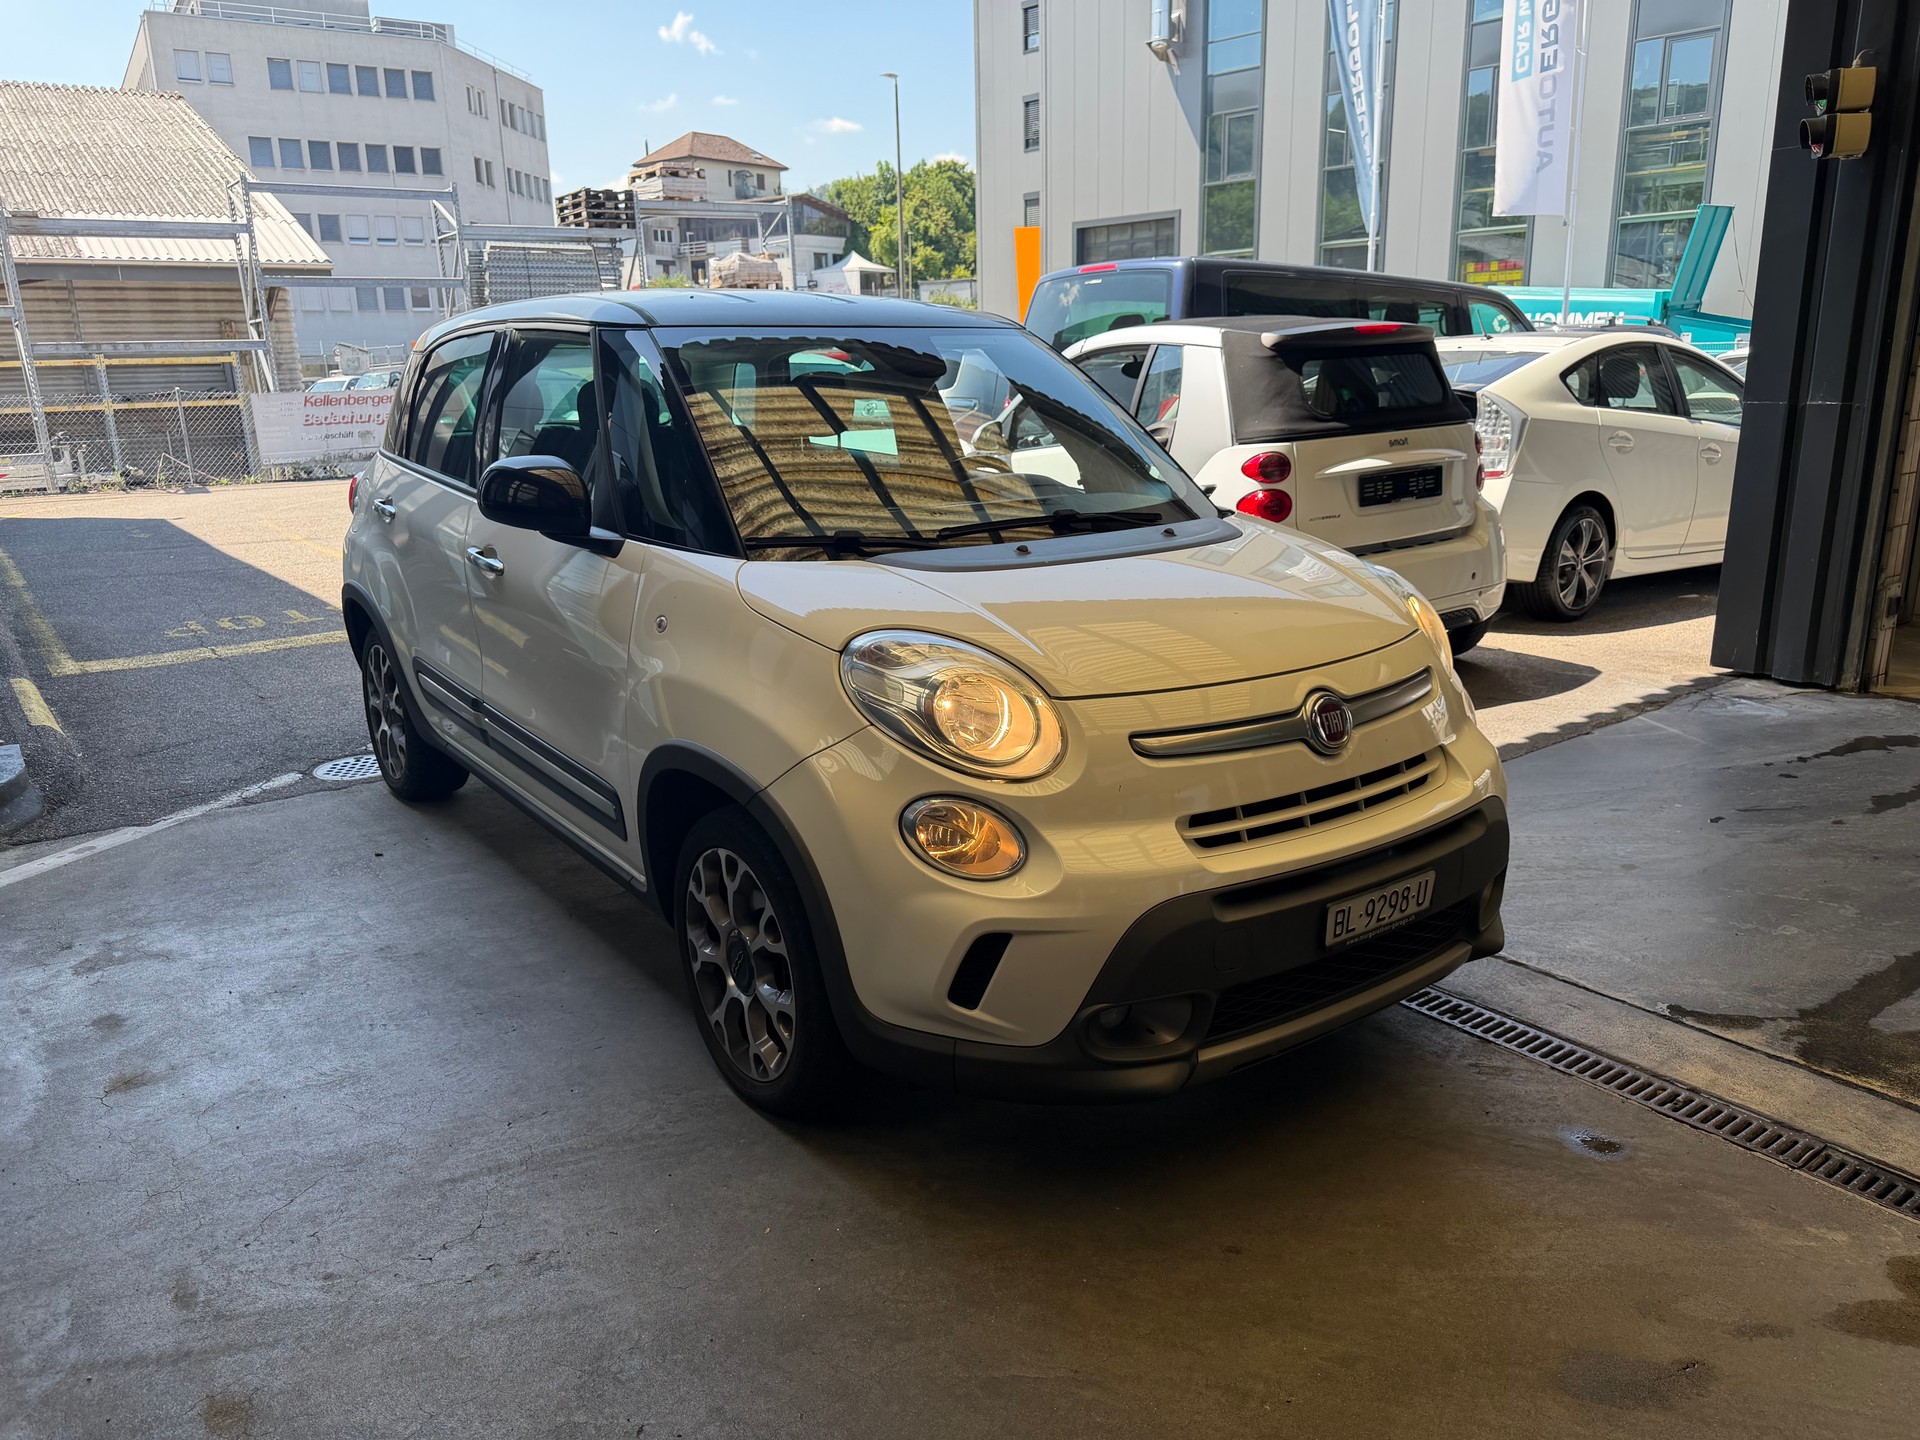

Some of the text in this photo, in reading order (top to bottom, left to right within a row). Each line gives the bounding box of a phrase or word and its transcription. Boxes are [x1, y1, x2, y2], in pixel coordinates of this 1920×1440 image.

[303, 394, 394, 407] Kellenberger
[1388, 437, 1409, 447] smart
[1321, 709, 1344, 735] FIAT
